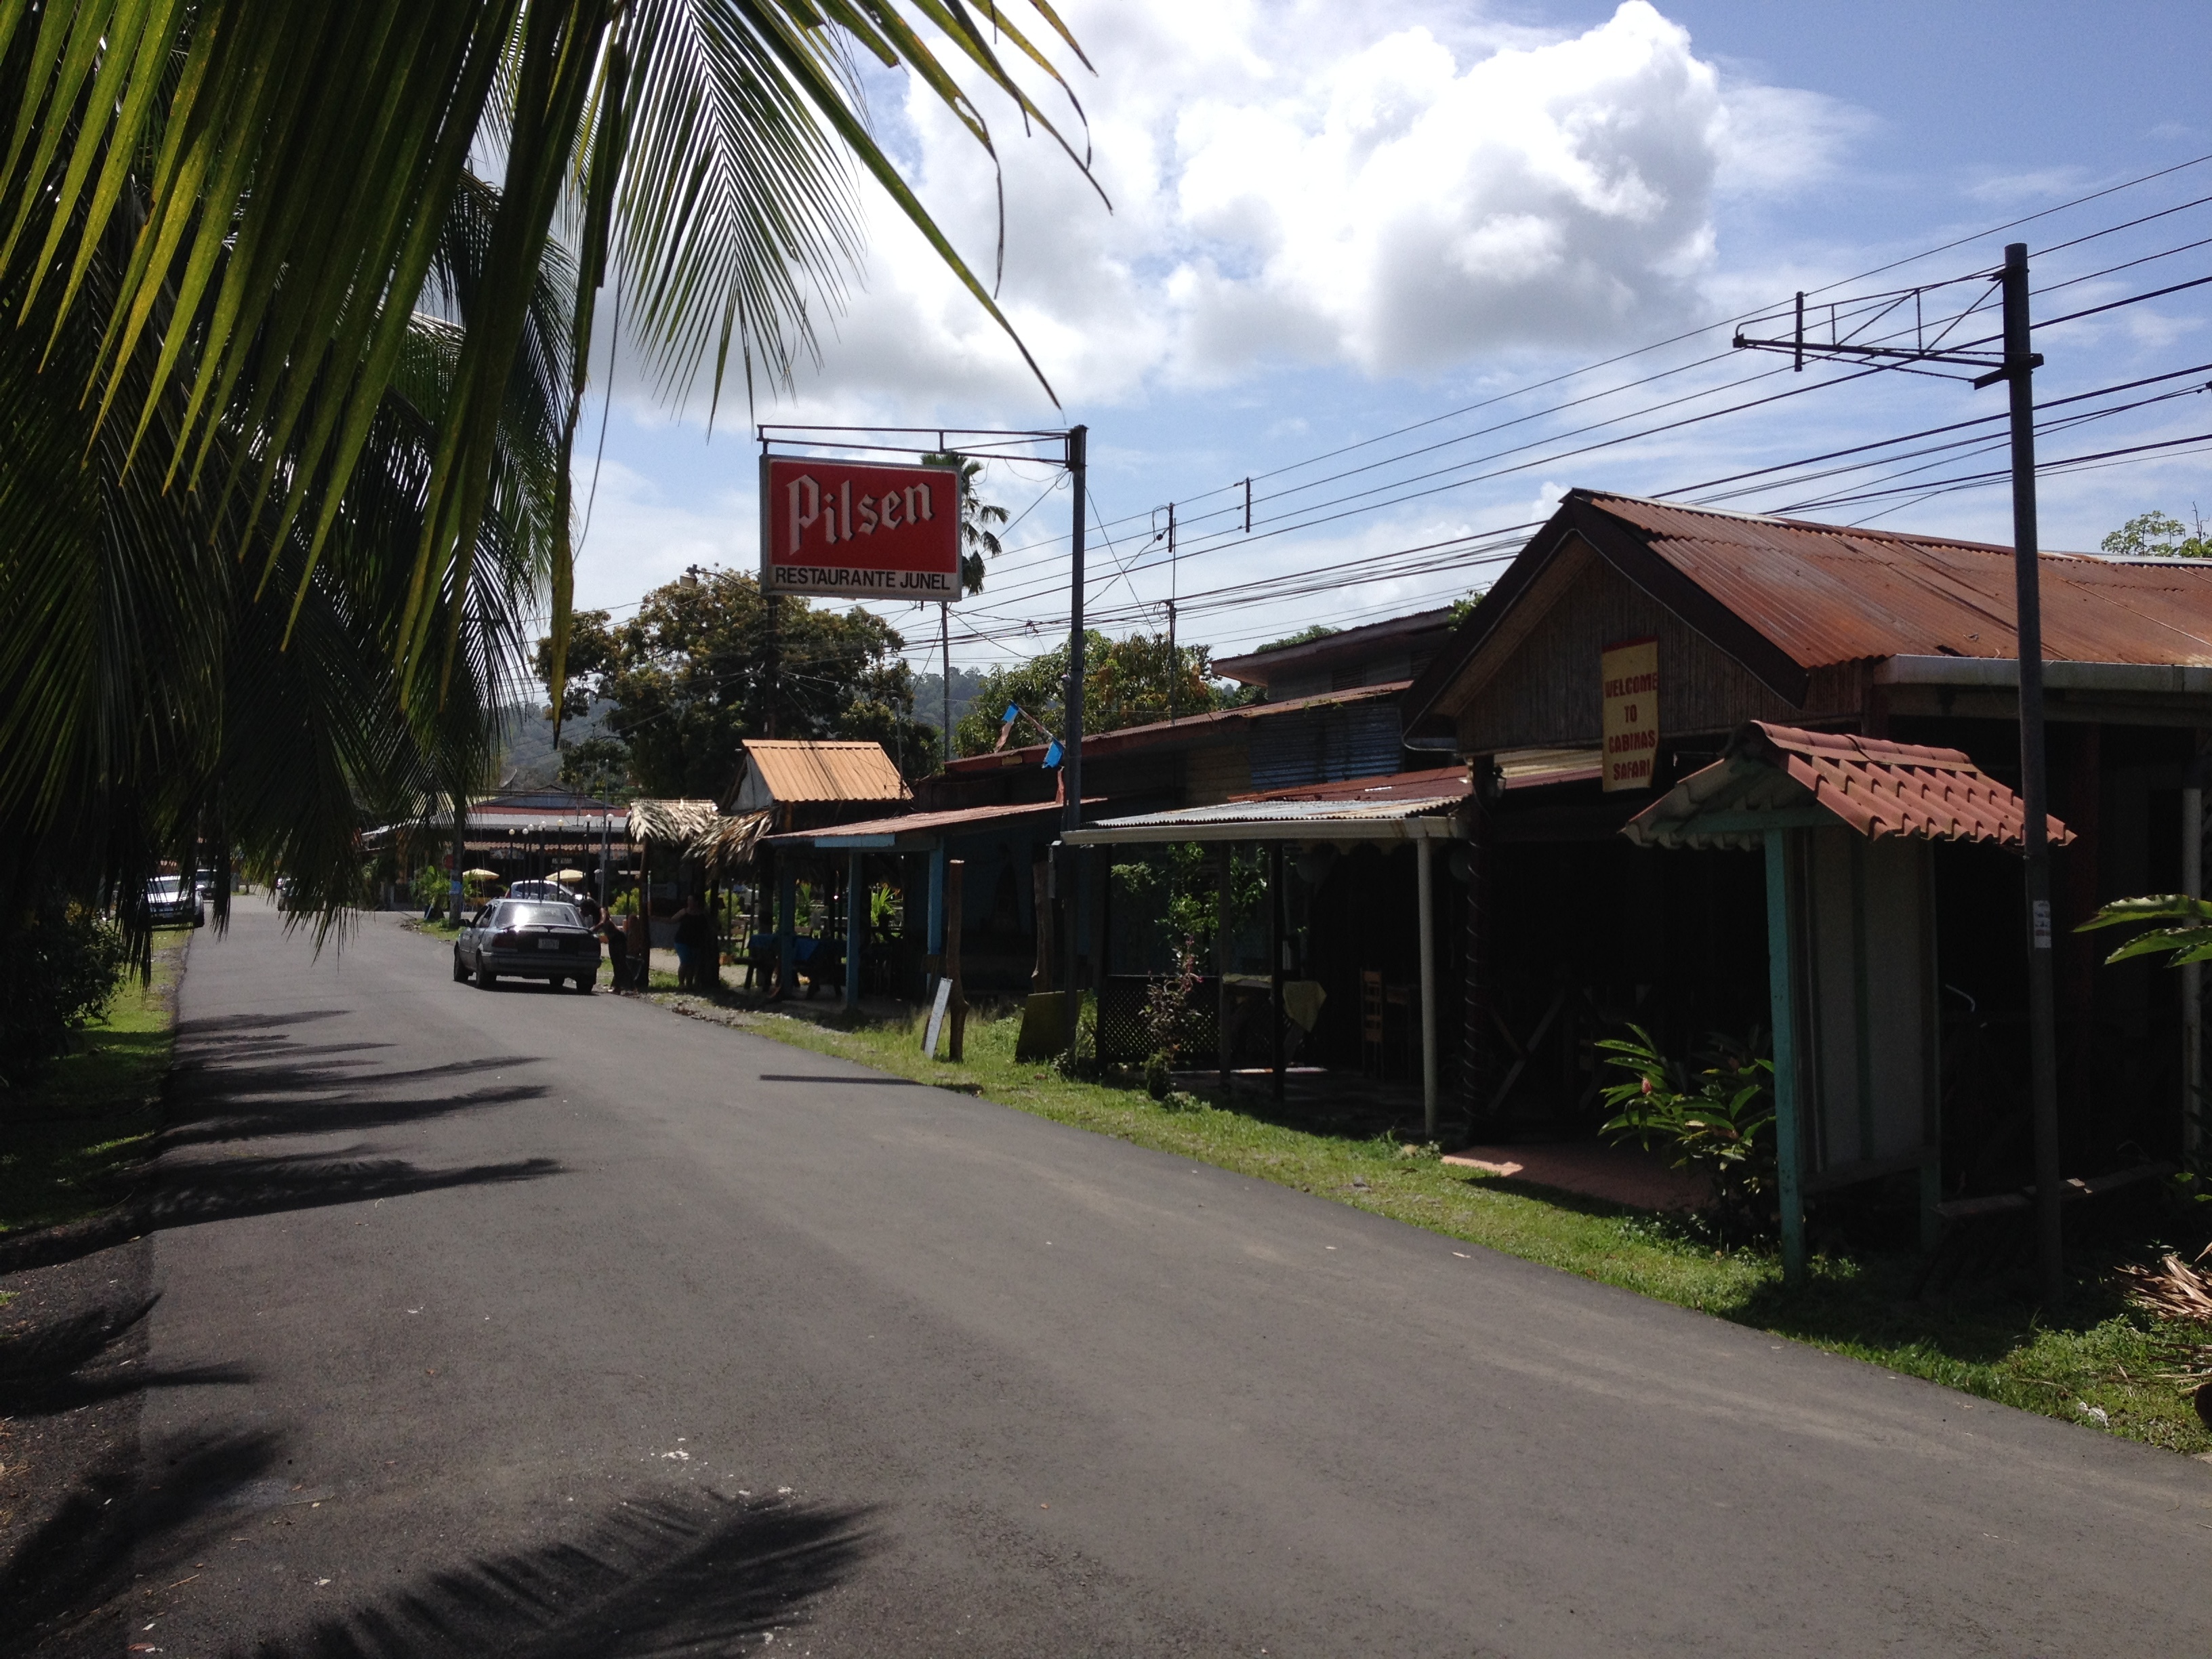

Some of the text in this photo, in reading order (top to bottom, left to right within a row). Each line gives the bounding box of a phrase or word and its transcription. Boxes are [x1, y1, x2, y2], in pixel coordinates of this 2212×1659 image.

[785, 474, 933, 556] Pilsen
[775, 567, 950, 590] RESTAURANTE JUNEL
[1605, 672, 1658, 699] WELCOME
[1624, 704, 1637, 723] TO
[1609, 729, 1656, 754] CABINAS
[1613, 759, 1650, 781] SAFARI
